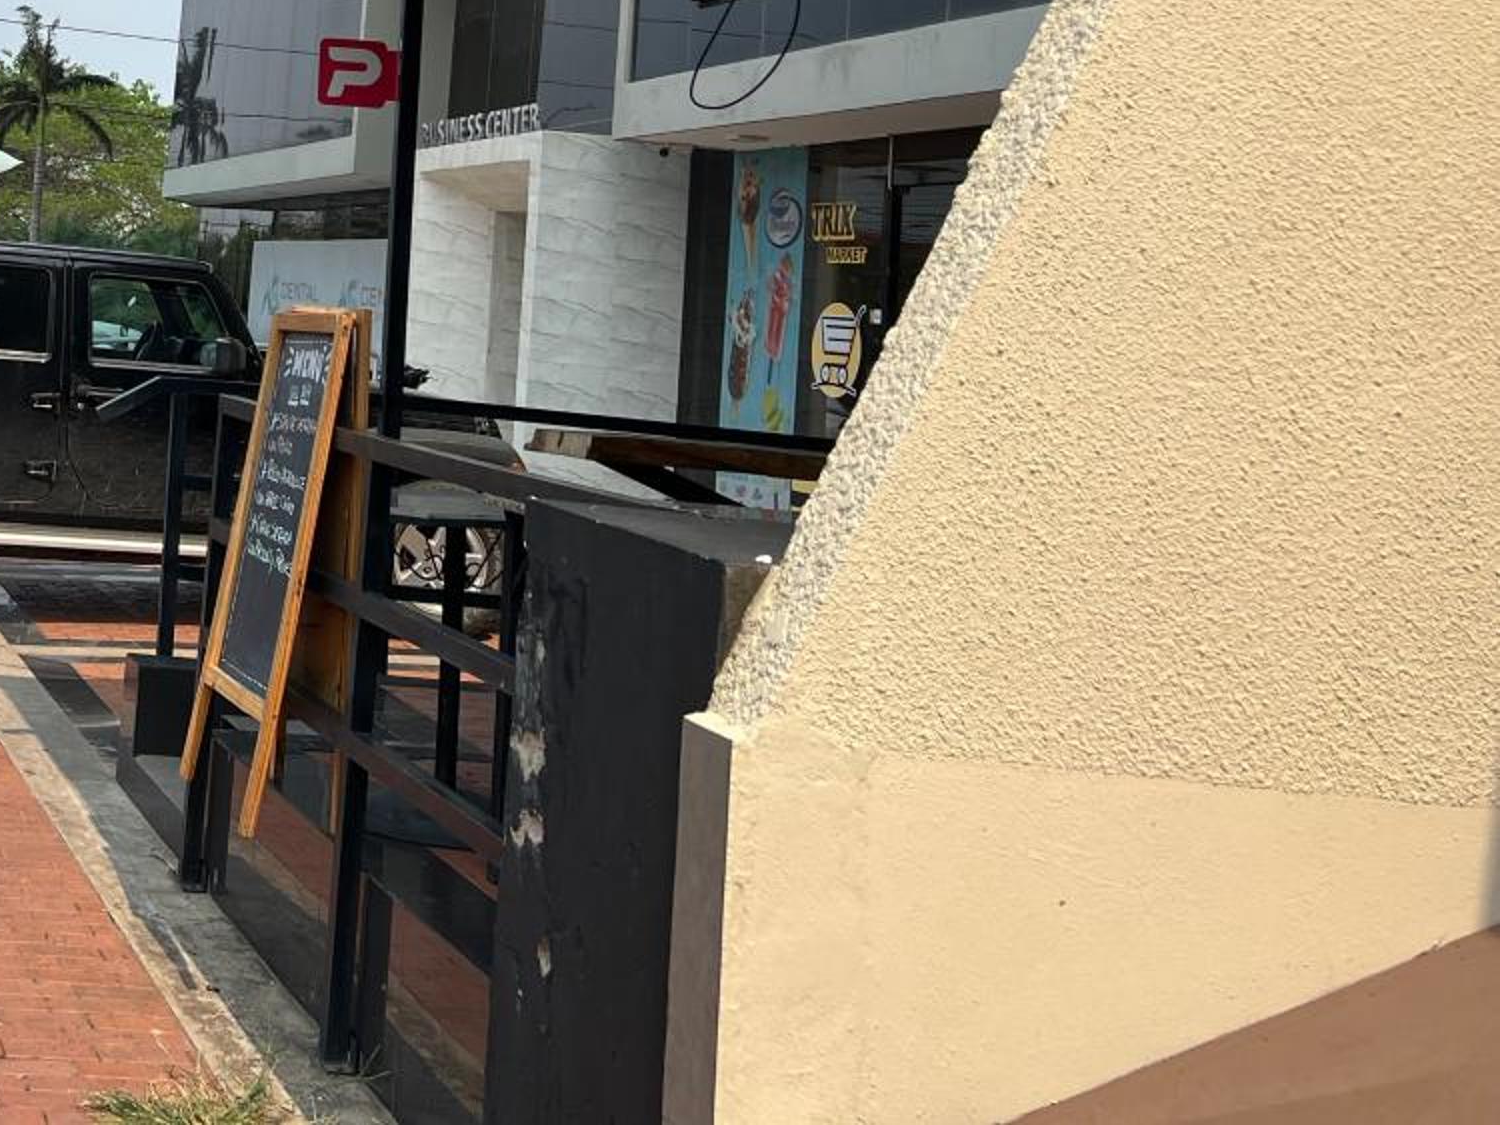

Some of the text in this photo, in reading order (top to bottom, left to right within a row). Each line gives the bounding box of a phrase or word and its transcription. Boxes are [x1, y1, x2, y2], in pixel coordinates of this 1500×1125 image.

[420, 103, 540, 148] BUSINESS CENTER
[813, 203, 856, 241] TRIX
[826, 247, 867, 263] MARKET
